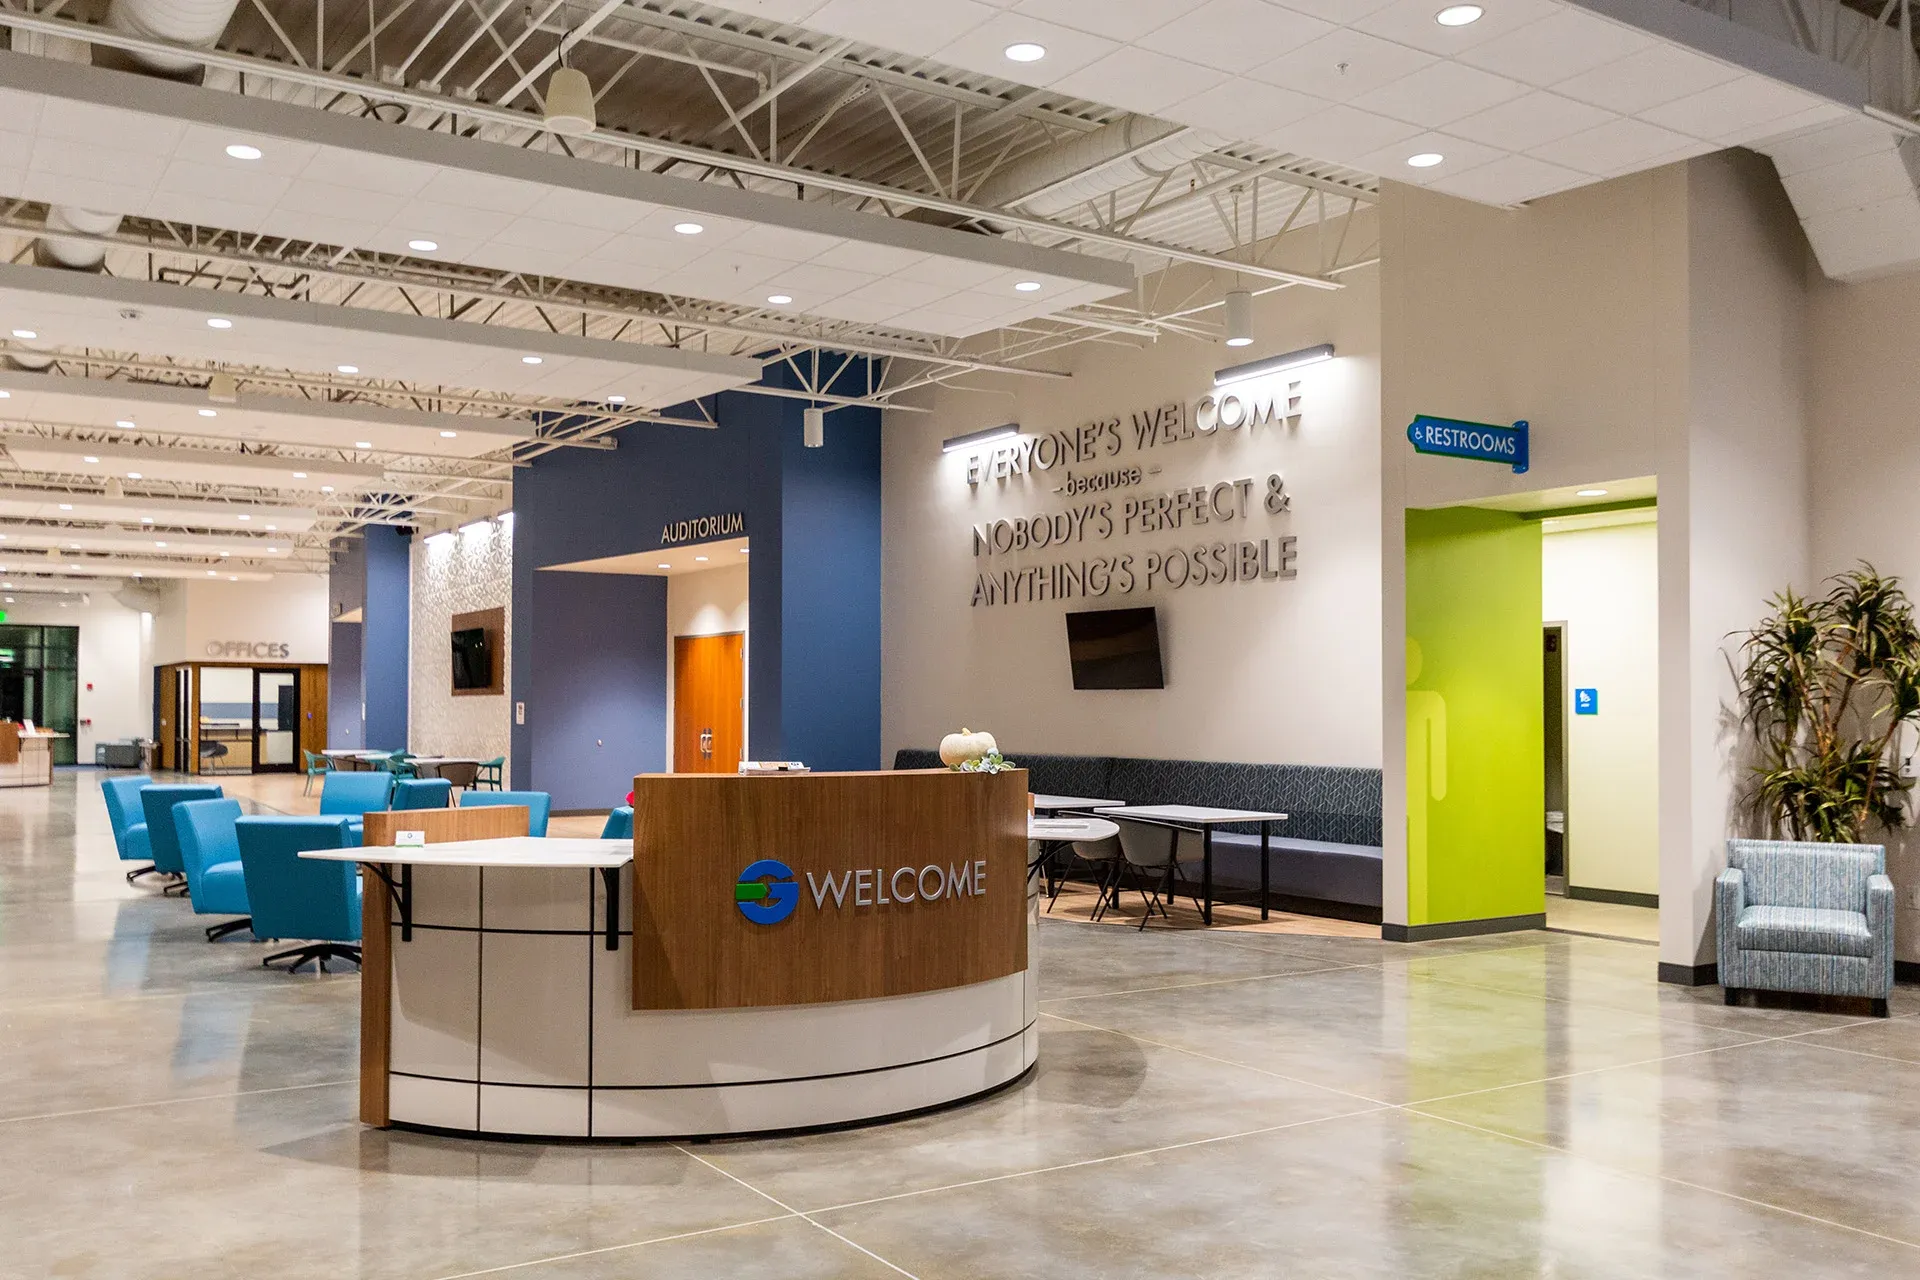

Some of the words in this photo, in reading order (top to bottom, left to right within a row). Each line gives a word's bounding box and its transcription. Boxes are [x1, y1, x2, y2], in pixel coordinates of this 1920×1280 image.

[966, 417, 1122, 485] EVERYONE'S
[1132, 380, 1303, 450] WELCOME
[1425, 425, 1516, 455] RESTROOMS
[661, 512, 744, 544] AUDITORIUM
[972, 501, 1113, 557] NOBODY'S
[1123, 477, 1253, 535] PERFECT
[1264, 473, 1292, 515] &
[970, 555, 1135, 607] ANYTHING'S
[1146, 536, 1298, 591] POSSIBLE
[206, 640, 290, 659] OFFICES
[806, 860, 987, 911] WELCOME
